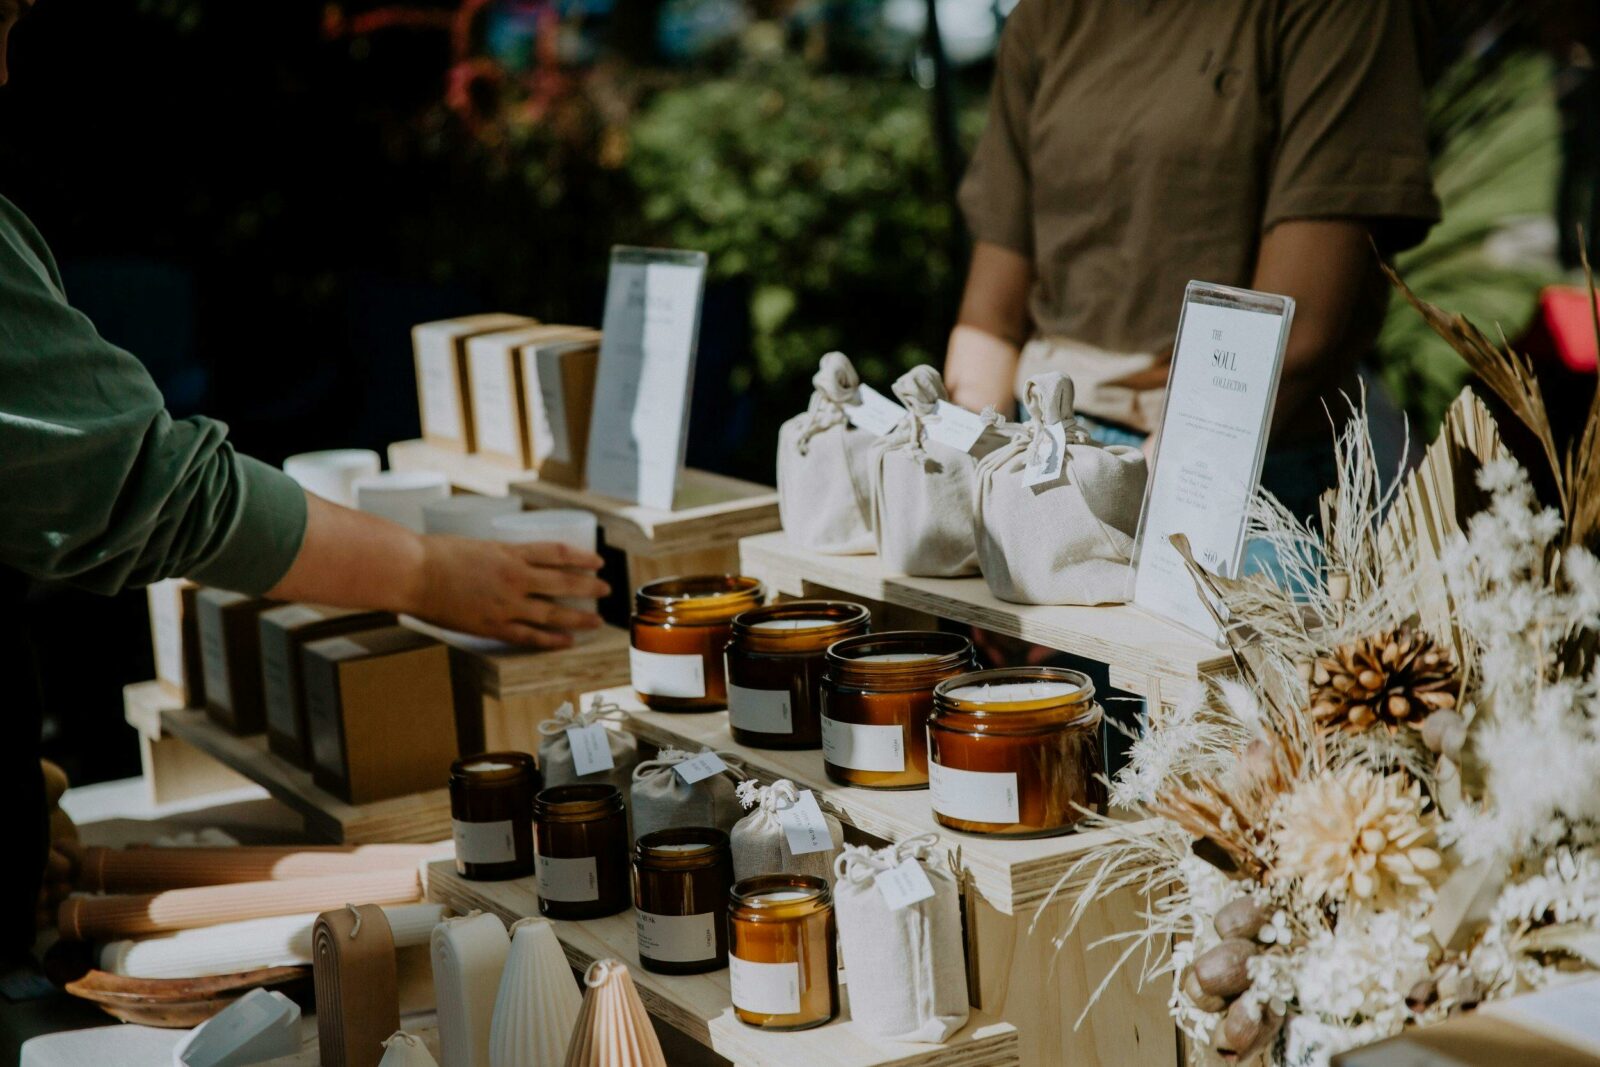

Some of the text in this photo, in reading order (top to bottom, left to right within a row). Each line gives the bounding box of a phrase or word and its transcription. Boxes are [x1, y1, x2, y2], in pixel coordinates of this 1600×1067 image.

[1212, 329, 1222, 340] THE
[1212, 349, 1237, 371] SOUL
[1212, 376, 1247, 392] COLLECTION
